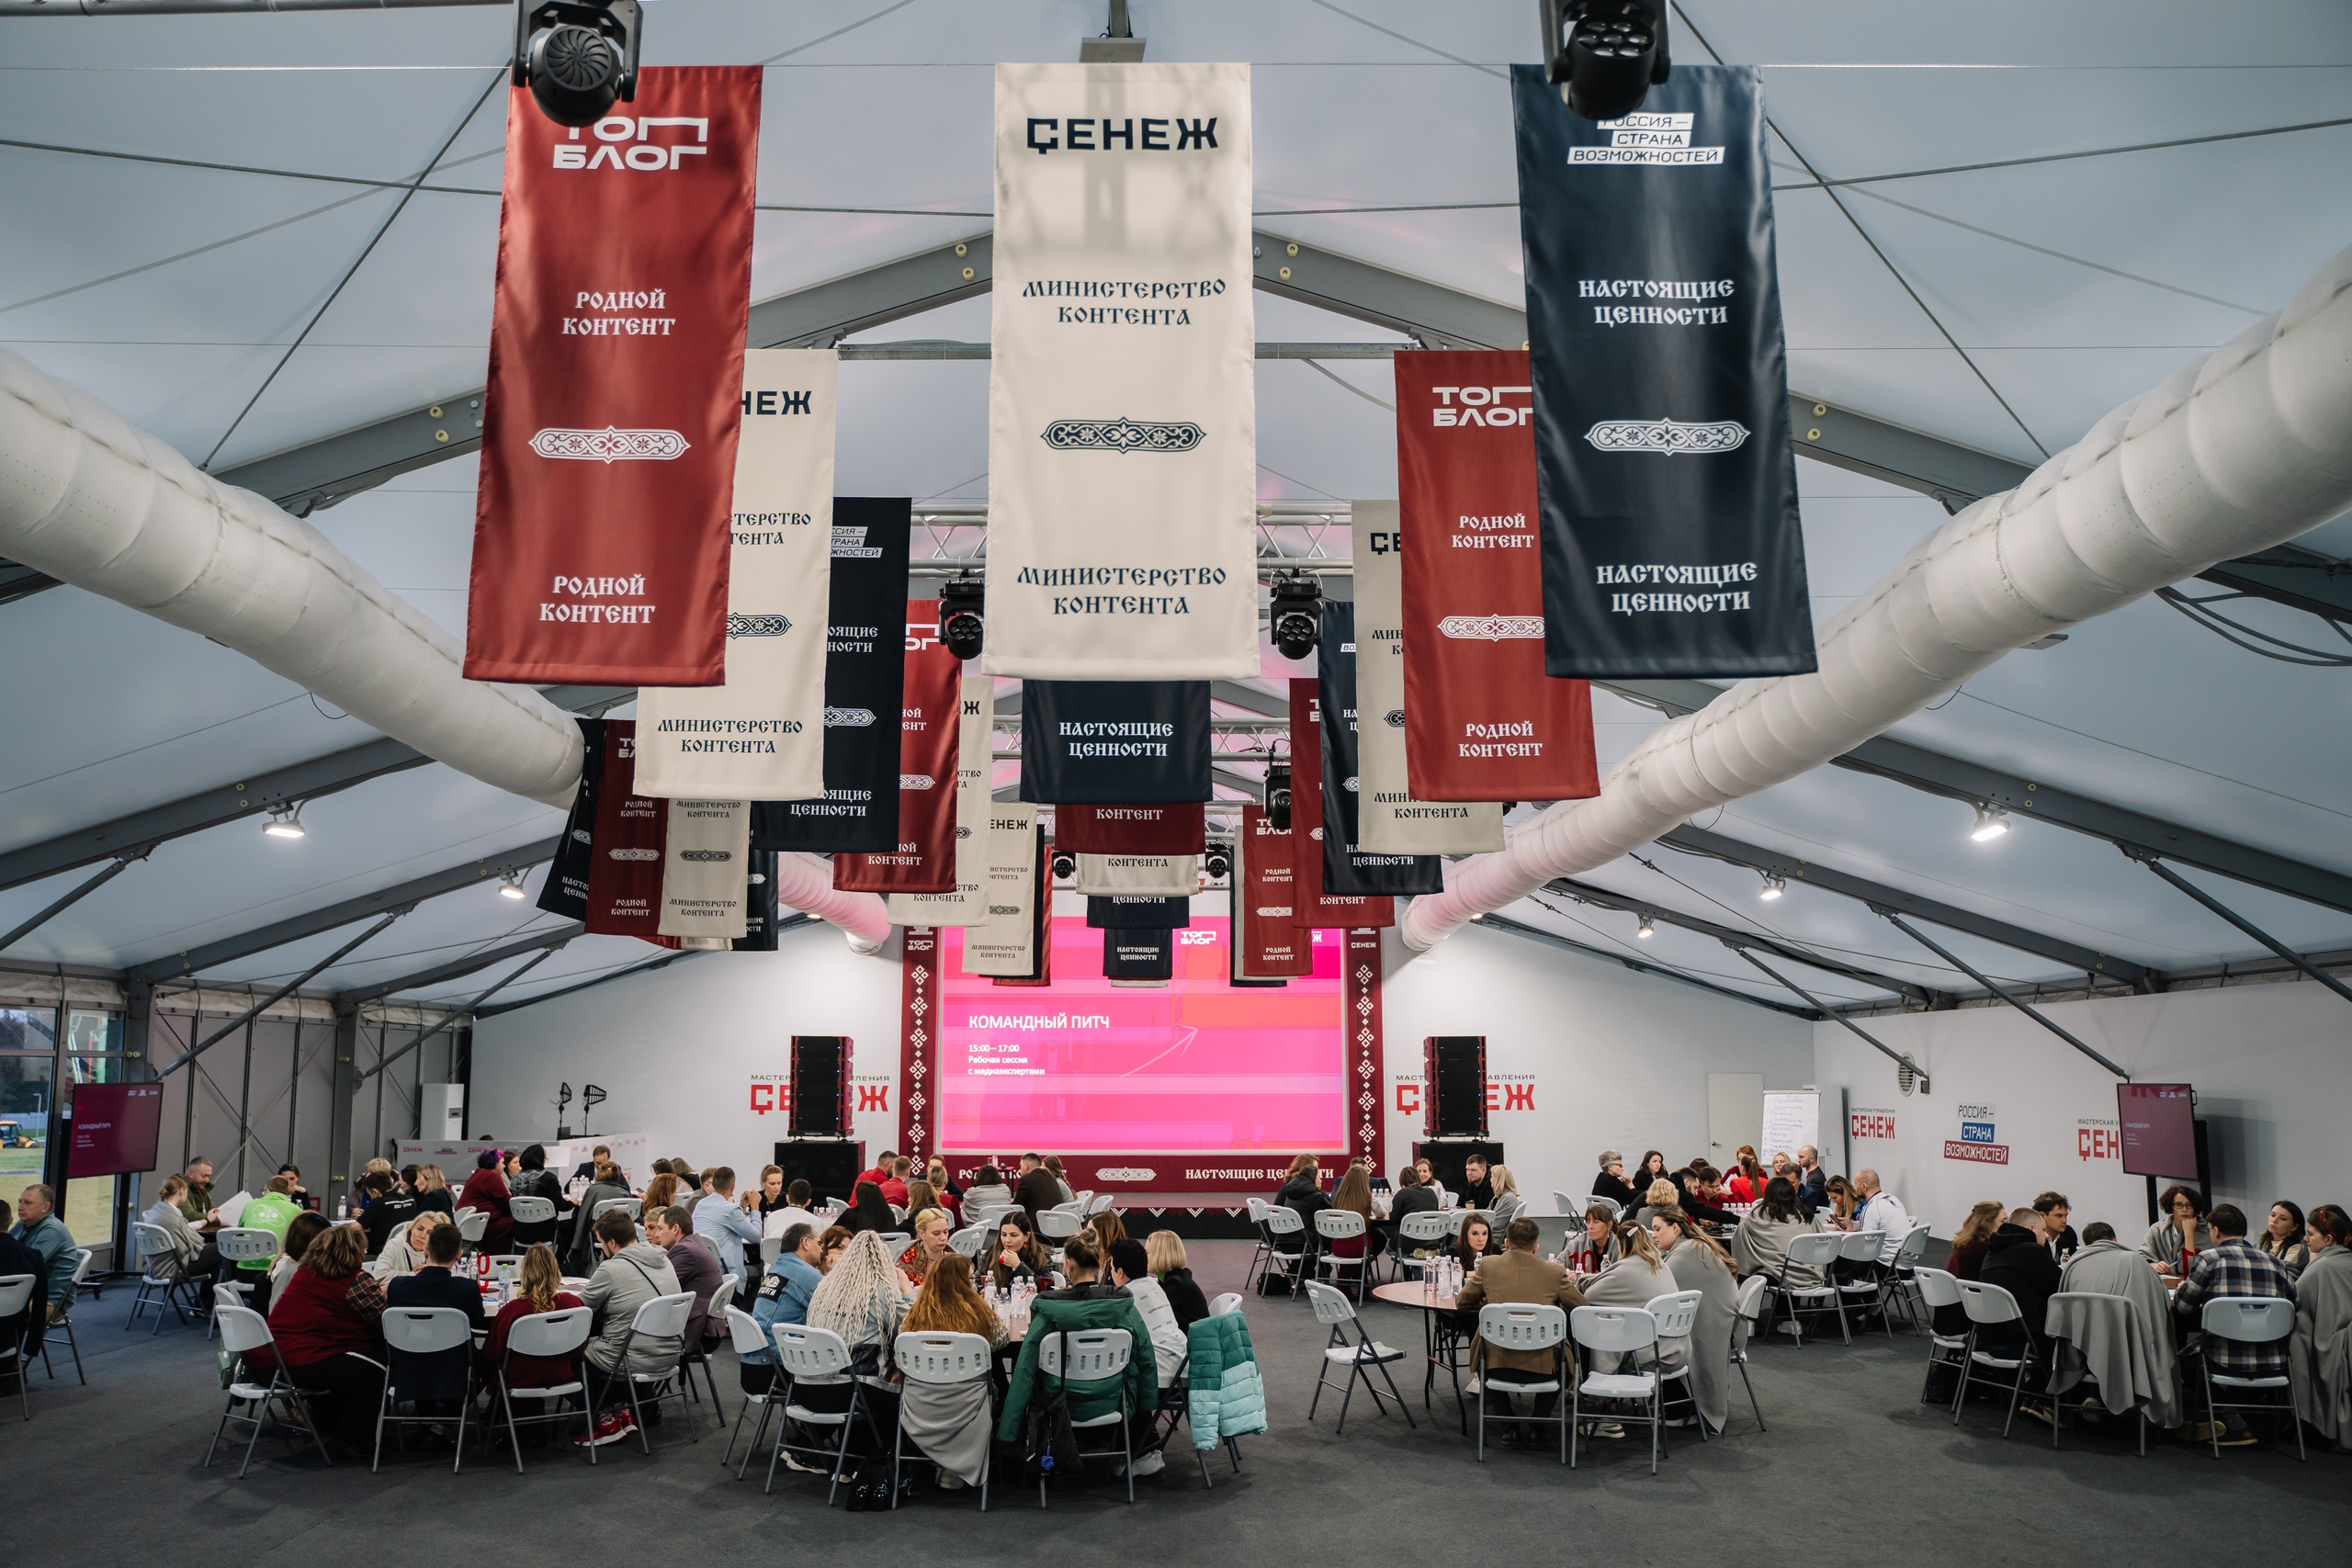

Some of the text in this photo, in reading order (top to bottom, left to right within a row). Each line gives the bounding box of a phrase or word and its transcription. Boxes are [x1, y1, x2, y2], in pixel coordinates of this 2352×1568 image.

[1617, 133, 1683, 146] СТРАНА
[553, 144, 707, 172] БЛОГ
[1573, 149, 1718, 164] ВОЗМОЖНОСТЕЙ
[1022, 278, 1227, 299] МИНИСТЕРСТВО
[1577, 279, 1736, 303] НАСТОЯЩИЕ
[575, 288, 667, 312] РОДНОЙ
[1057, 306, 1193, 325] КОНТЕНТА
[1594, 306, 1728, 328] ЦЕННОСТИ
[561, 317, 677, 336] КОНТЕНТ
[741, 390, 812, 415] НЕЖ
[731, 513, 811, 526] ТЕРСТВО
[1459, 513, 1526, 532] РОДНОЙ
[730, 532, 785, 546] ТЕНТА
[831, 538, 861, 547] ТРАНА
[1451, 534, 1534, 549] КОНТЕНТ
[831, 548, 879, 557] ЖНОСТЕЙ
[1016, 566, 1227, 588] МИНИСТЕРСТВО
[1596, 562, 1758, 589] НАСТОЯЩИЕ
[552, 574, 646, 599] РОДНОЙ
[1053, 595, 1191, 615] КОНТЕНТА
[1611, 591, 1751, 616] ЦЕННОСТИ
[538, 603, 656, 625] КОНТЕНТ
[828, 626, 879, 639] ОЯЩИЕ
[827, 641, 874, 653] НОСТИ
[657, 719, 803, 734] МИНИСТЕРСТВО
[1058, 722, 1174, 739] НАСТОЯЩИЕ
[1464, 720, 1534, 739] РОДНОЙ
[681, 739, 776, 754] КОНТЕНТА
[1069, 742, 1168, 760] ЦЕННОСТИ
[1458, 743, 1544, 758] КОНТЕНТ
[625, 800, 653, 808] РОДНОЙ
[676, 800, 741, 809] МИНИСТЕРСТВО
[790, 804, 867, 818] ЦЕННОСТИ
[620, 809, 657, 818] КОНТЕНТ
[686, 810, 730, 818] КОНТЕНТА
[1096, 808, 1163, 820] КОНТЕНТ
[1395, 807, 1469, 818] КОНТЕНТА
[868, 855, 922, 866] КОНТЕНТ
[1107, 857, 1169, 868] КОНТЕНТА
[1352, 856, 1414, 867] ЦЕННОСТИ
[616, 898, 647, 908] РОДНОЙ
[669, 898, 738, 908] МИНИСТЕРСТВО
[913, 894, 966, 903] КОНТЕНТА
[1112, 896, 1166, 904] ЦЕННОСТИ
[1319, 897, 1366, 905] КОНТЕНТ
[611, 908, 650, 917] КОНТЕНТ
[681, 908, 725, 918] КОНТЕНТА
[968, 1012, 1110, 1032] КОМАНДНЫЙ ПИТЧ
[968, 1044, 990, 1053] 15:00
[998, 1044, 1020, 1053] 17:00
[968, 1055, 1001, 1064] Рабочая
[1958, 1105, 1988, 1119] РОССИЯ
[2077, 1118, 2114, 1126] МАСТЕРСКАЯ
[1962, 1125, 1993, 1141] СТРАНА
[2078, 1128, 2120, 1162] СЕН
[1945, 1143, 2007, 1163] ВОЗМОЖНОСТЕЙ
[1185, 1168, 1264, 1180] НАСТОЯЩИЕ
[1568, 1249, 1598, 1275] 10
